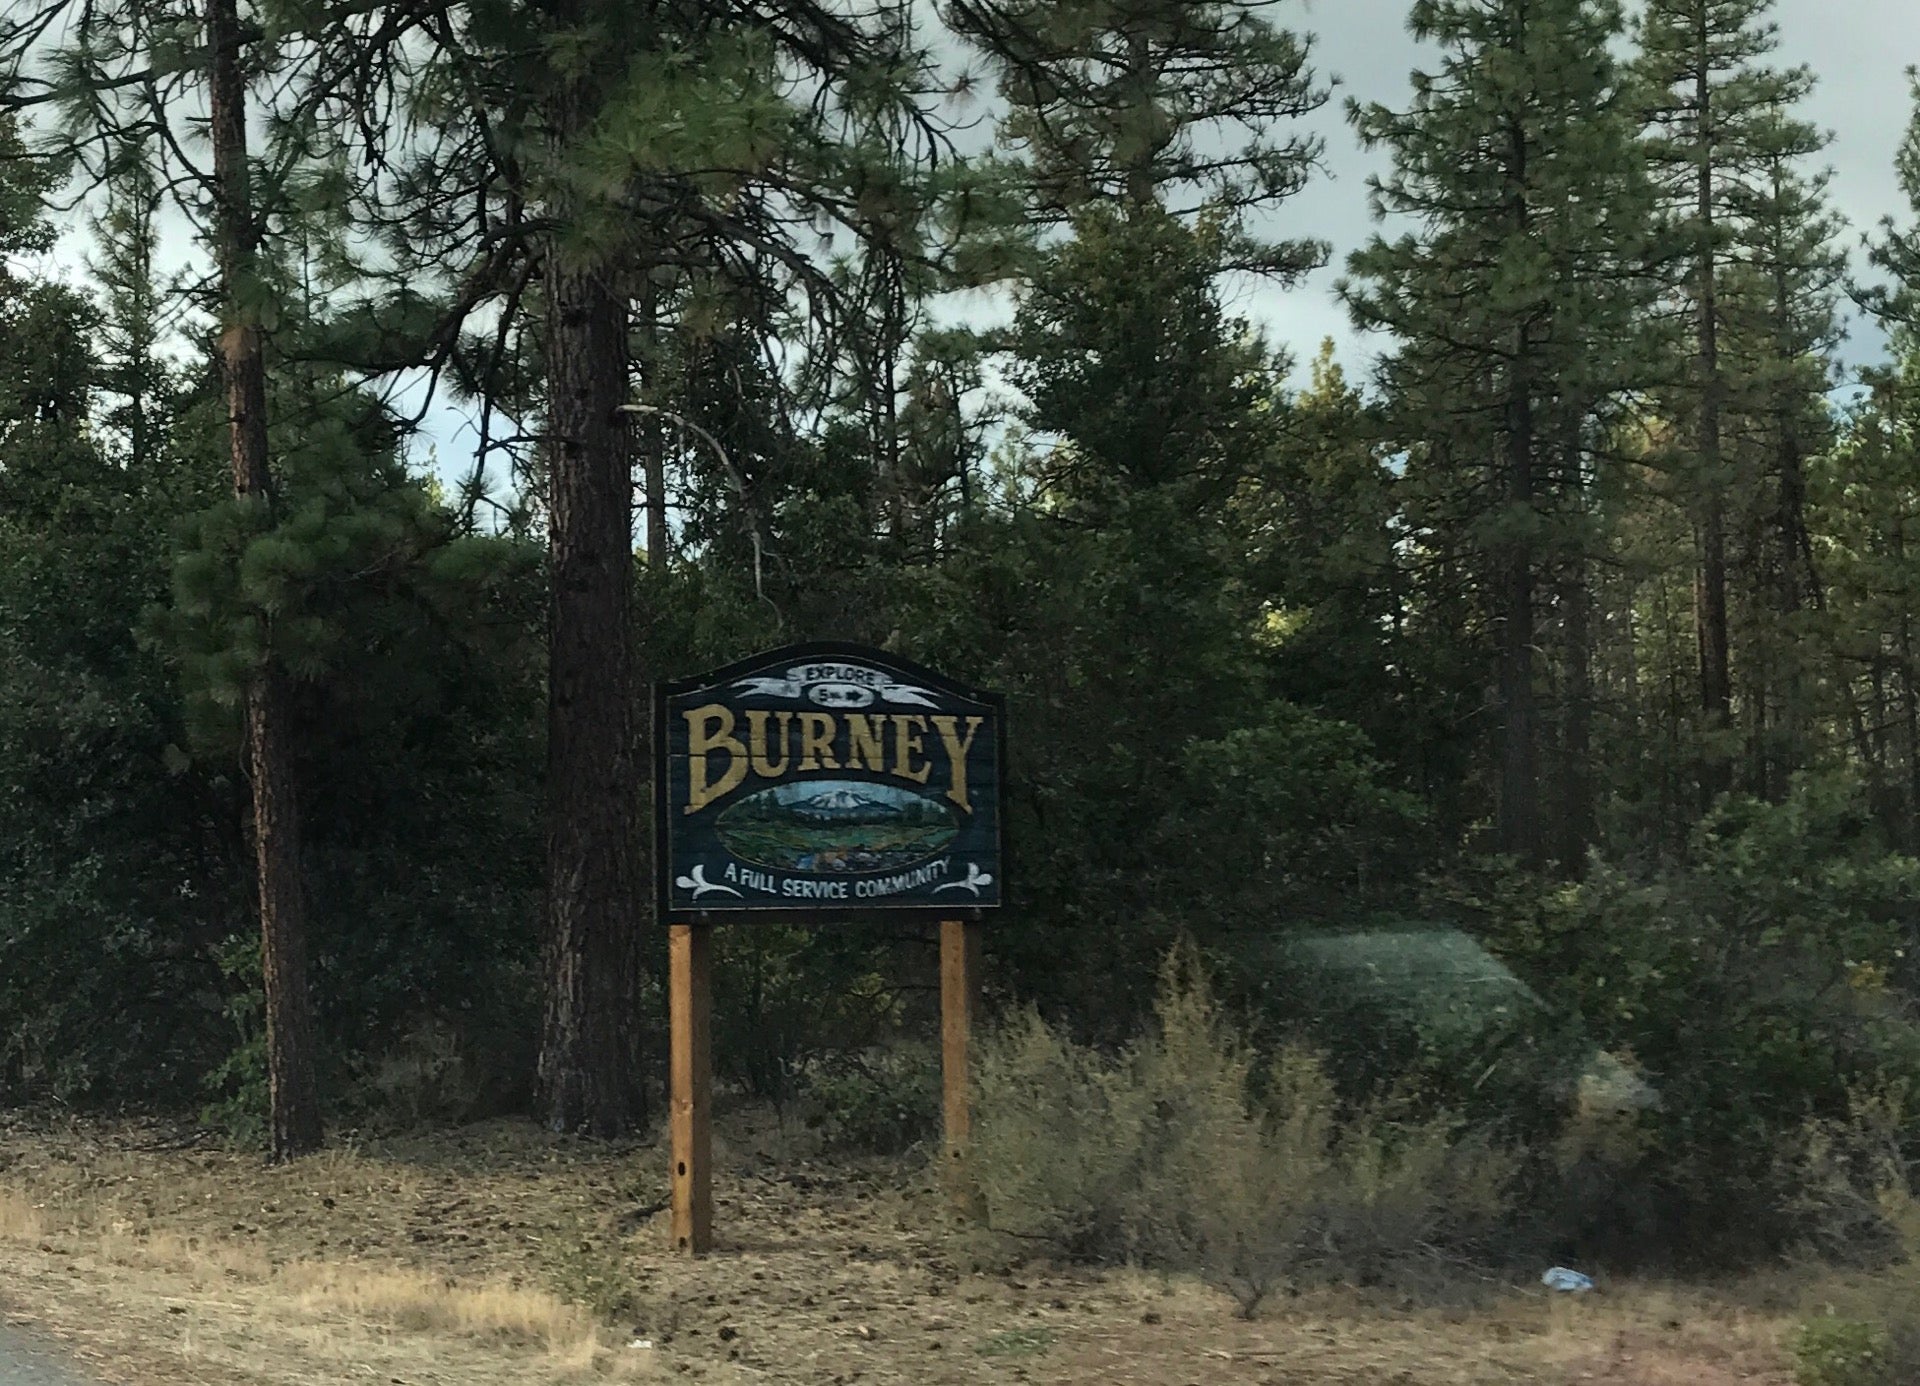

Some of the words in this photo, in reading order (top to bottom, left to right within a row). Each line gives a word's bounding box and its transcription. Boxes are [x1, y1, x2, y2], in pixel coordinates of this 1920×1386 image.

[806, 666, 875, 686] EXPLORE
[682, 703, 984, 815] BURNEY
[724, 862, 737, 882] A
[740, 868, 777, 894] FULL
[782, 878, 849, 899] SERVICE
[855, 856, 951, 898] COMMUNITY
